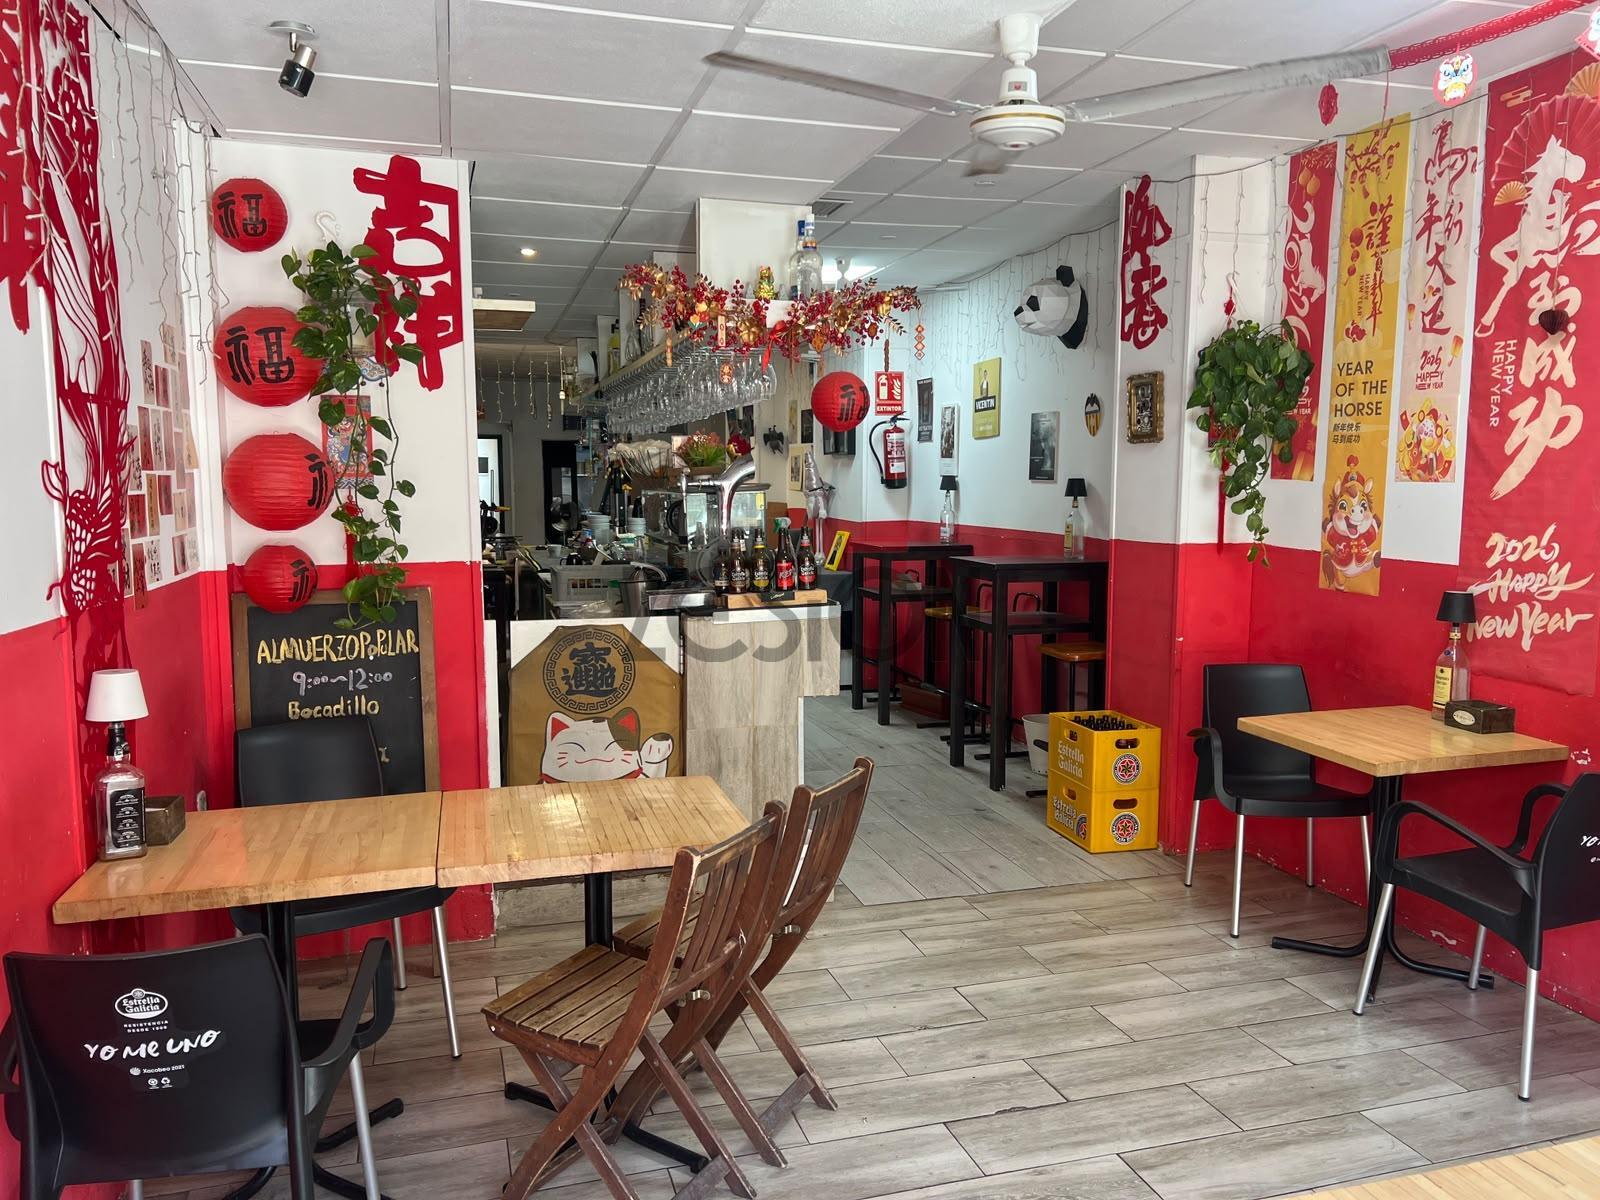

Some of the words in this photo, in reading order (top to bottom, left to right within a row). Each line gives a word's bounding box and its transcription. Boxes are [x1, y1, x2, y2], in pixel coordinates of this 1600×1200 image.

[217, 191, 268, 239] 福
[225, 325, 295, 386] 福
[1491, 341, 1506, 379] NEW
[1337, 360, 1374, 376] YEAR
[1415, 371, 1444, 382] HAPPY
[1502, 340, 1518, 395] HAPPY
[1335, 383, 1355, 397] OF
[1362, 380, 1388, 395] THE
[1334, 401, 1382, 417] HORSE
[1489, 383, 1501, 428] YEAR
[1485, 522, 1560, 568] 2026
[1516, 601, 1594, 651] Year
[288, 694, 380, 720] Bocadillo
[1058, 741, 1085, 764] Estrella
[1058, 755, 1083, 778] Galicia
[1580, 835, 1599, 847] YO
[122, 996, 160, 1006] Estrella
[125, 1004, 160, 1013] Galicia
[84, 1043, 118, 1061] YO
[166, 1030, 221, 1054] UNO
[142, 1066, 170, 1074] Xacobeo
